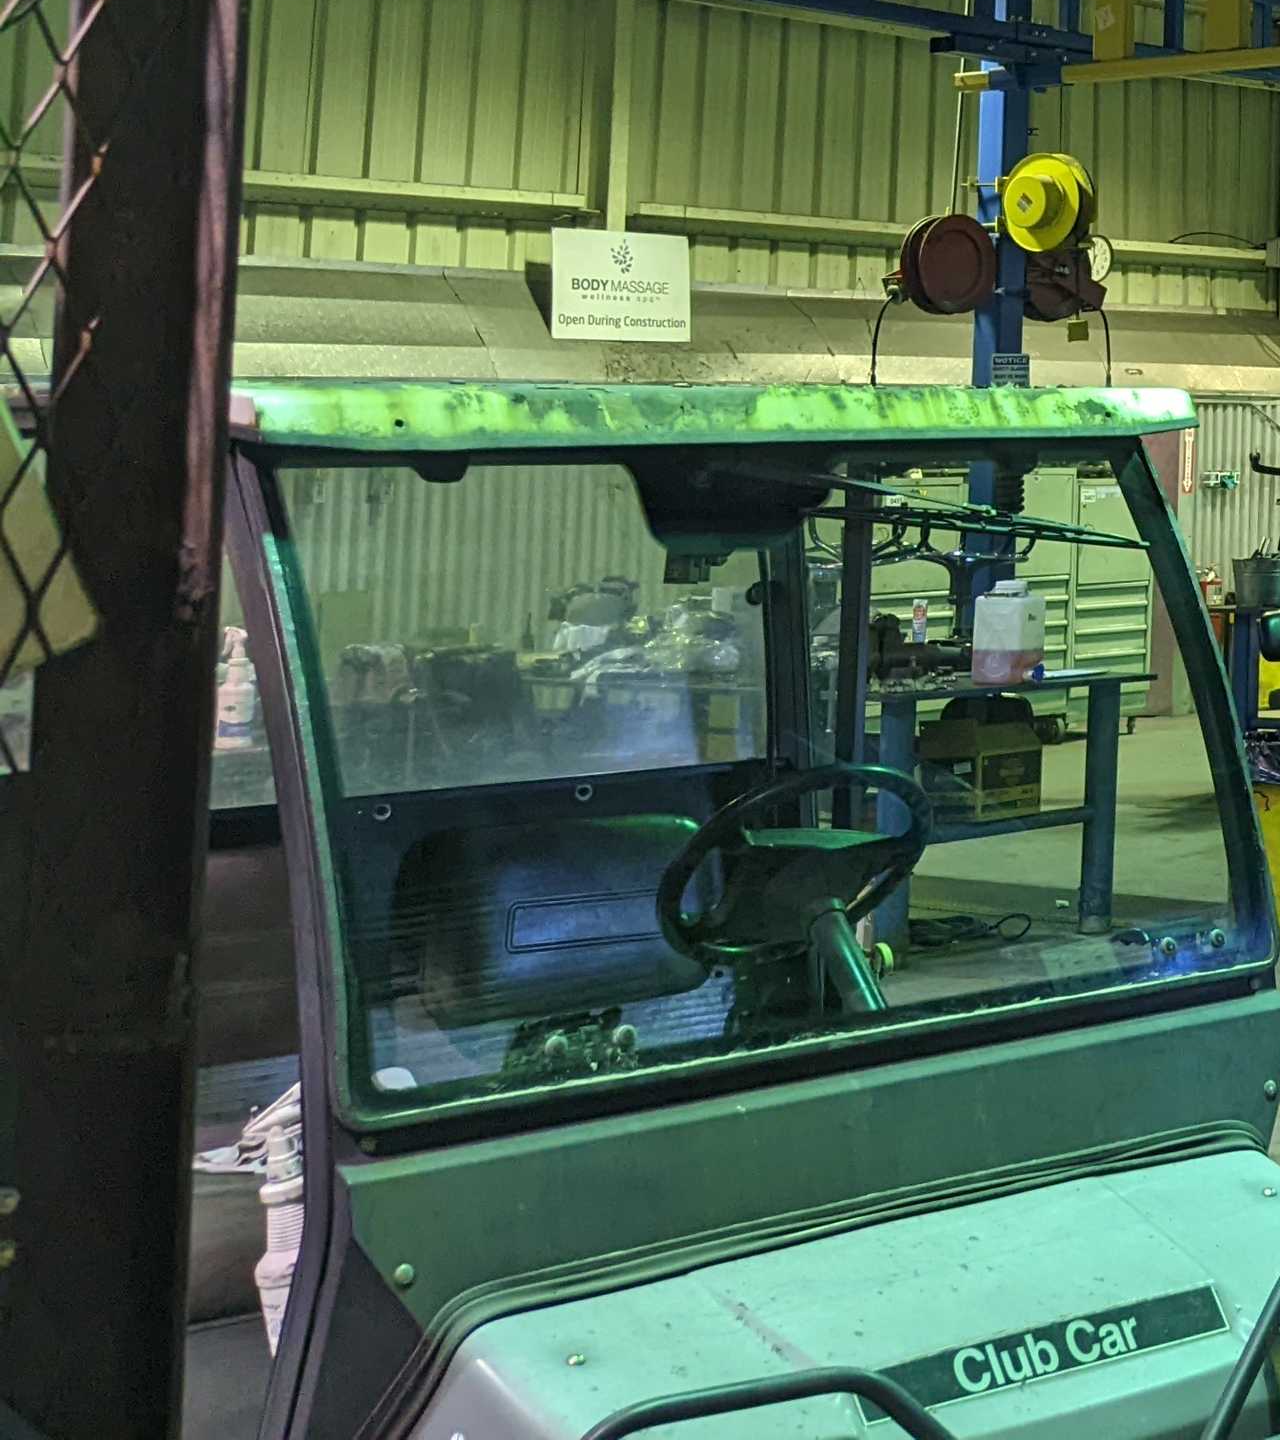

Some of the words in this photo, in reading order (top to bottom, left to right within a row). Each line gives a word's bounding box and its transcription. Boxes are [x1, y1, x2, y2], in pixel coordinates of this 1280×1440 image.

[571, 278, 609, 291] BODY
[610, 280, 670, 295] MASSAGE
[581, 293, 631, 302] wellness
[558, 313, 585, 327] Open
[588, 314, 621, 329] During
[624, 316, 687, 329] Construction
[953, 1333, 1059, 1393] Club
[1065, 1316, 1138, 1362] Car
